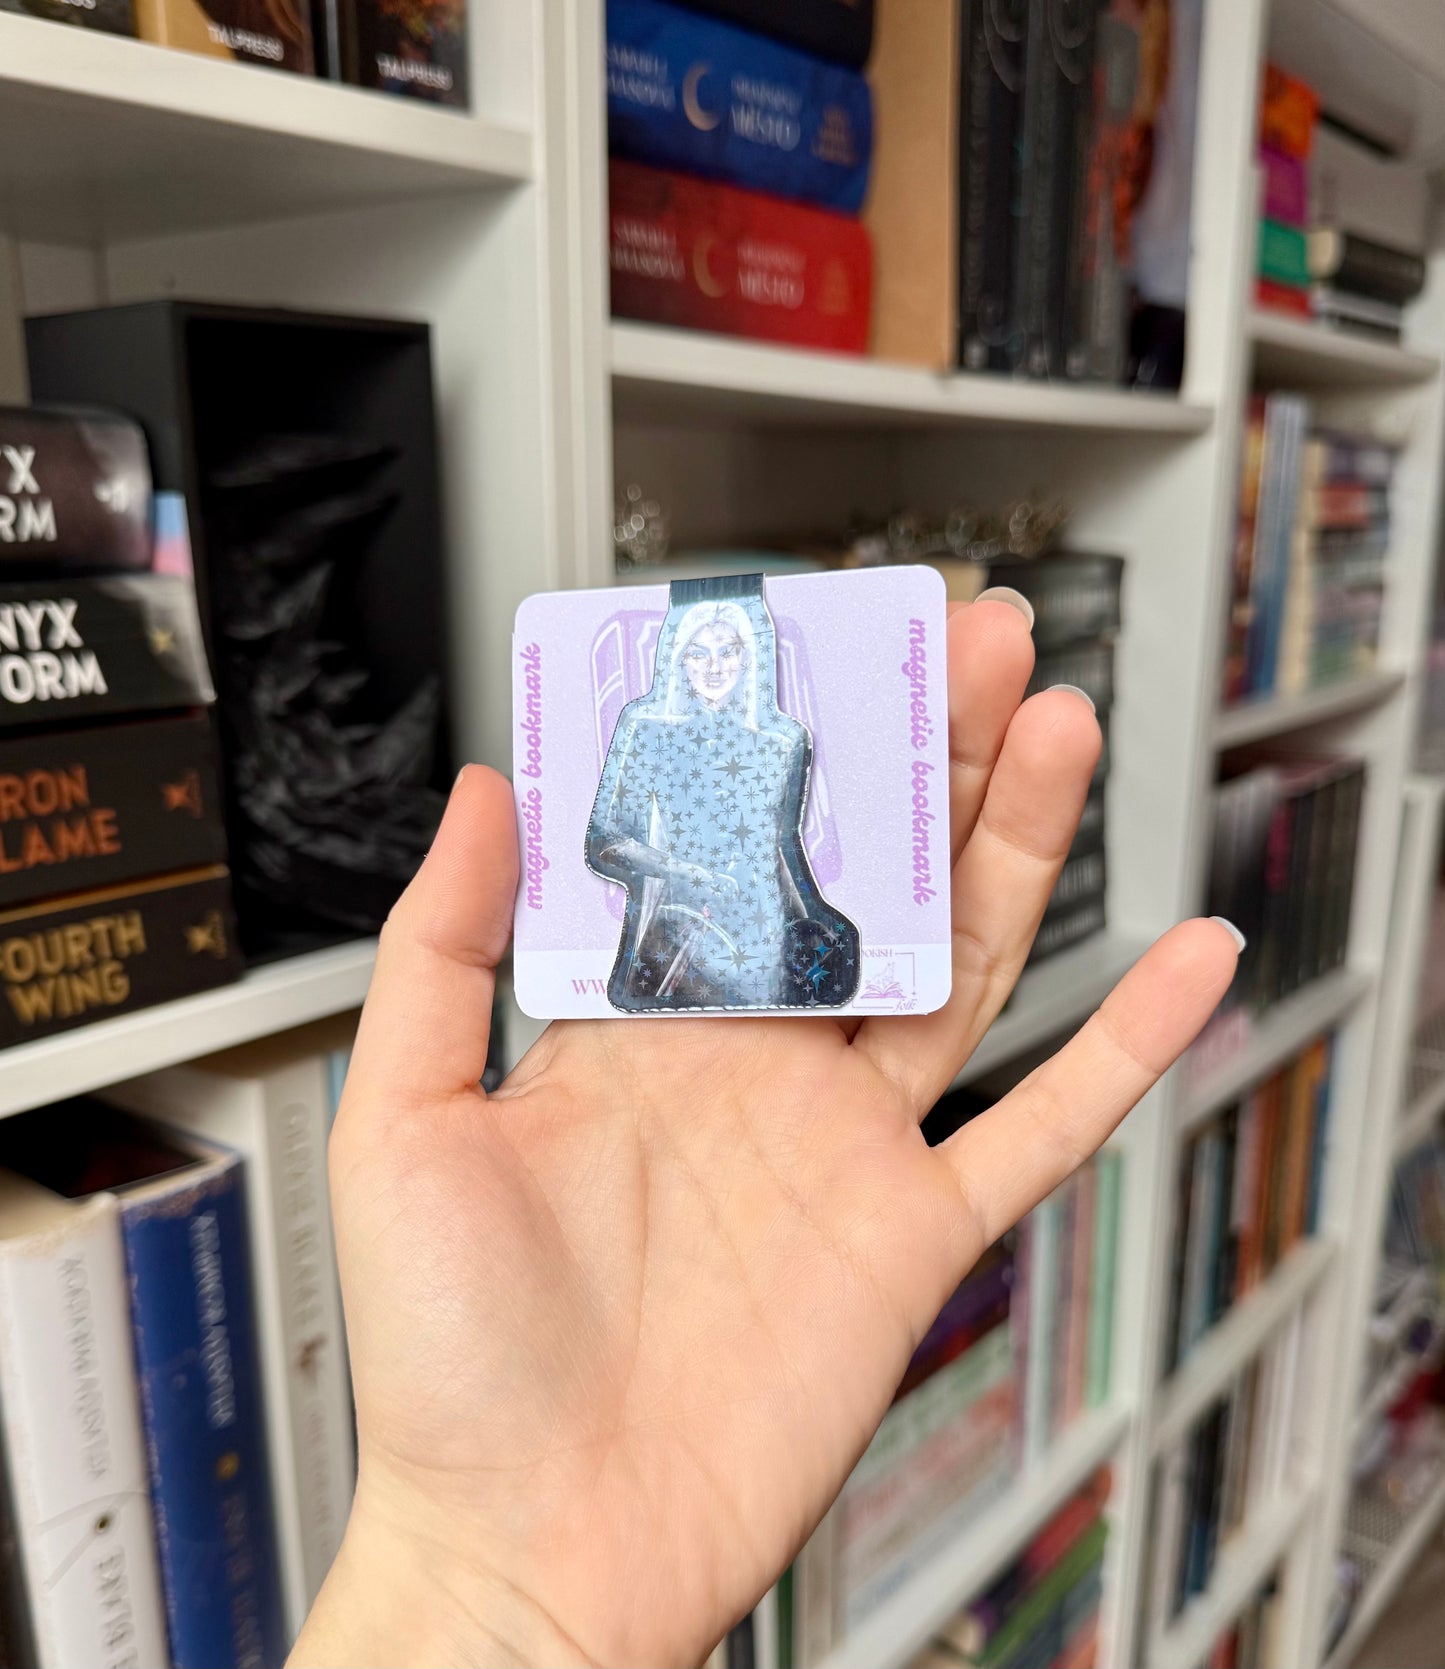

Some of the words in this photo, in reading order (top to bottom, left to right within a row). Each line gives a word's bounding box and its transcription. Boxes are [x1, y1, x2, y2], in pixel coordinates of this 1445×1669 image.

[520, 642, 543, 779] bookmark
[901, 618, 934, 751] magnetic
[521, 787, 550, 910] magnetic
[911, 760, 937, 906] bookmark
[0, 909, 147, 983] OURTH
[6, 960, 131, 1025] WING
